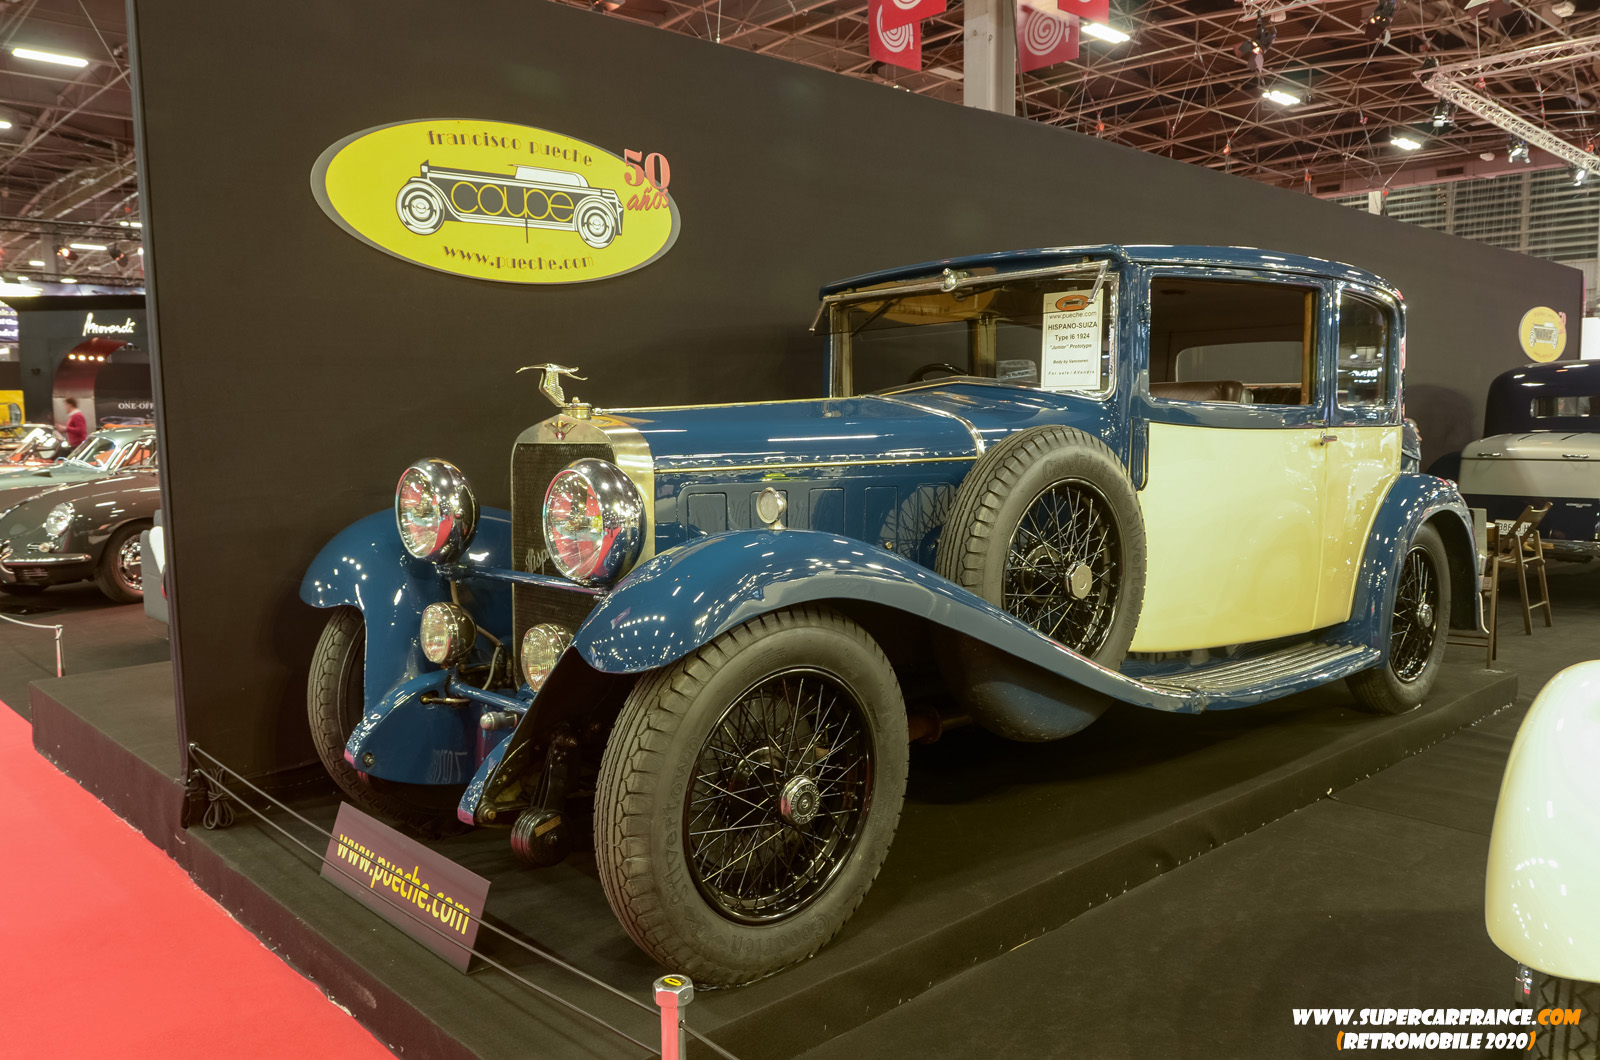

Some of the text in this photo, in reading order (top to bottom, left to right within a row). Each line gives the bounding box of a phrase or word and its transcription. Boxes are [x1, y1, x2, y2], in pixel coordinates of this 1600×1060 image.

[427, 130, 593, 167] francisco pueche
[624, 148, 671, 190] 50
[451, 181, 574, 243] coupe
[626, 187, 671, 211] años
[443, 245, 594, 270] www.pueche.com
[1048, 321, 1097, 330] HISPANO-SUIZA
[1055, 334, 1068, 342] Type
[337, 834, 471, 935] www.pueche.com
